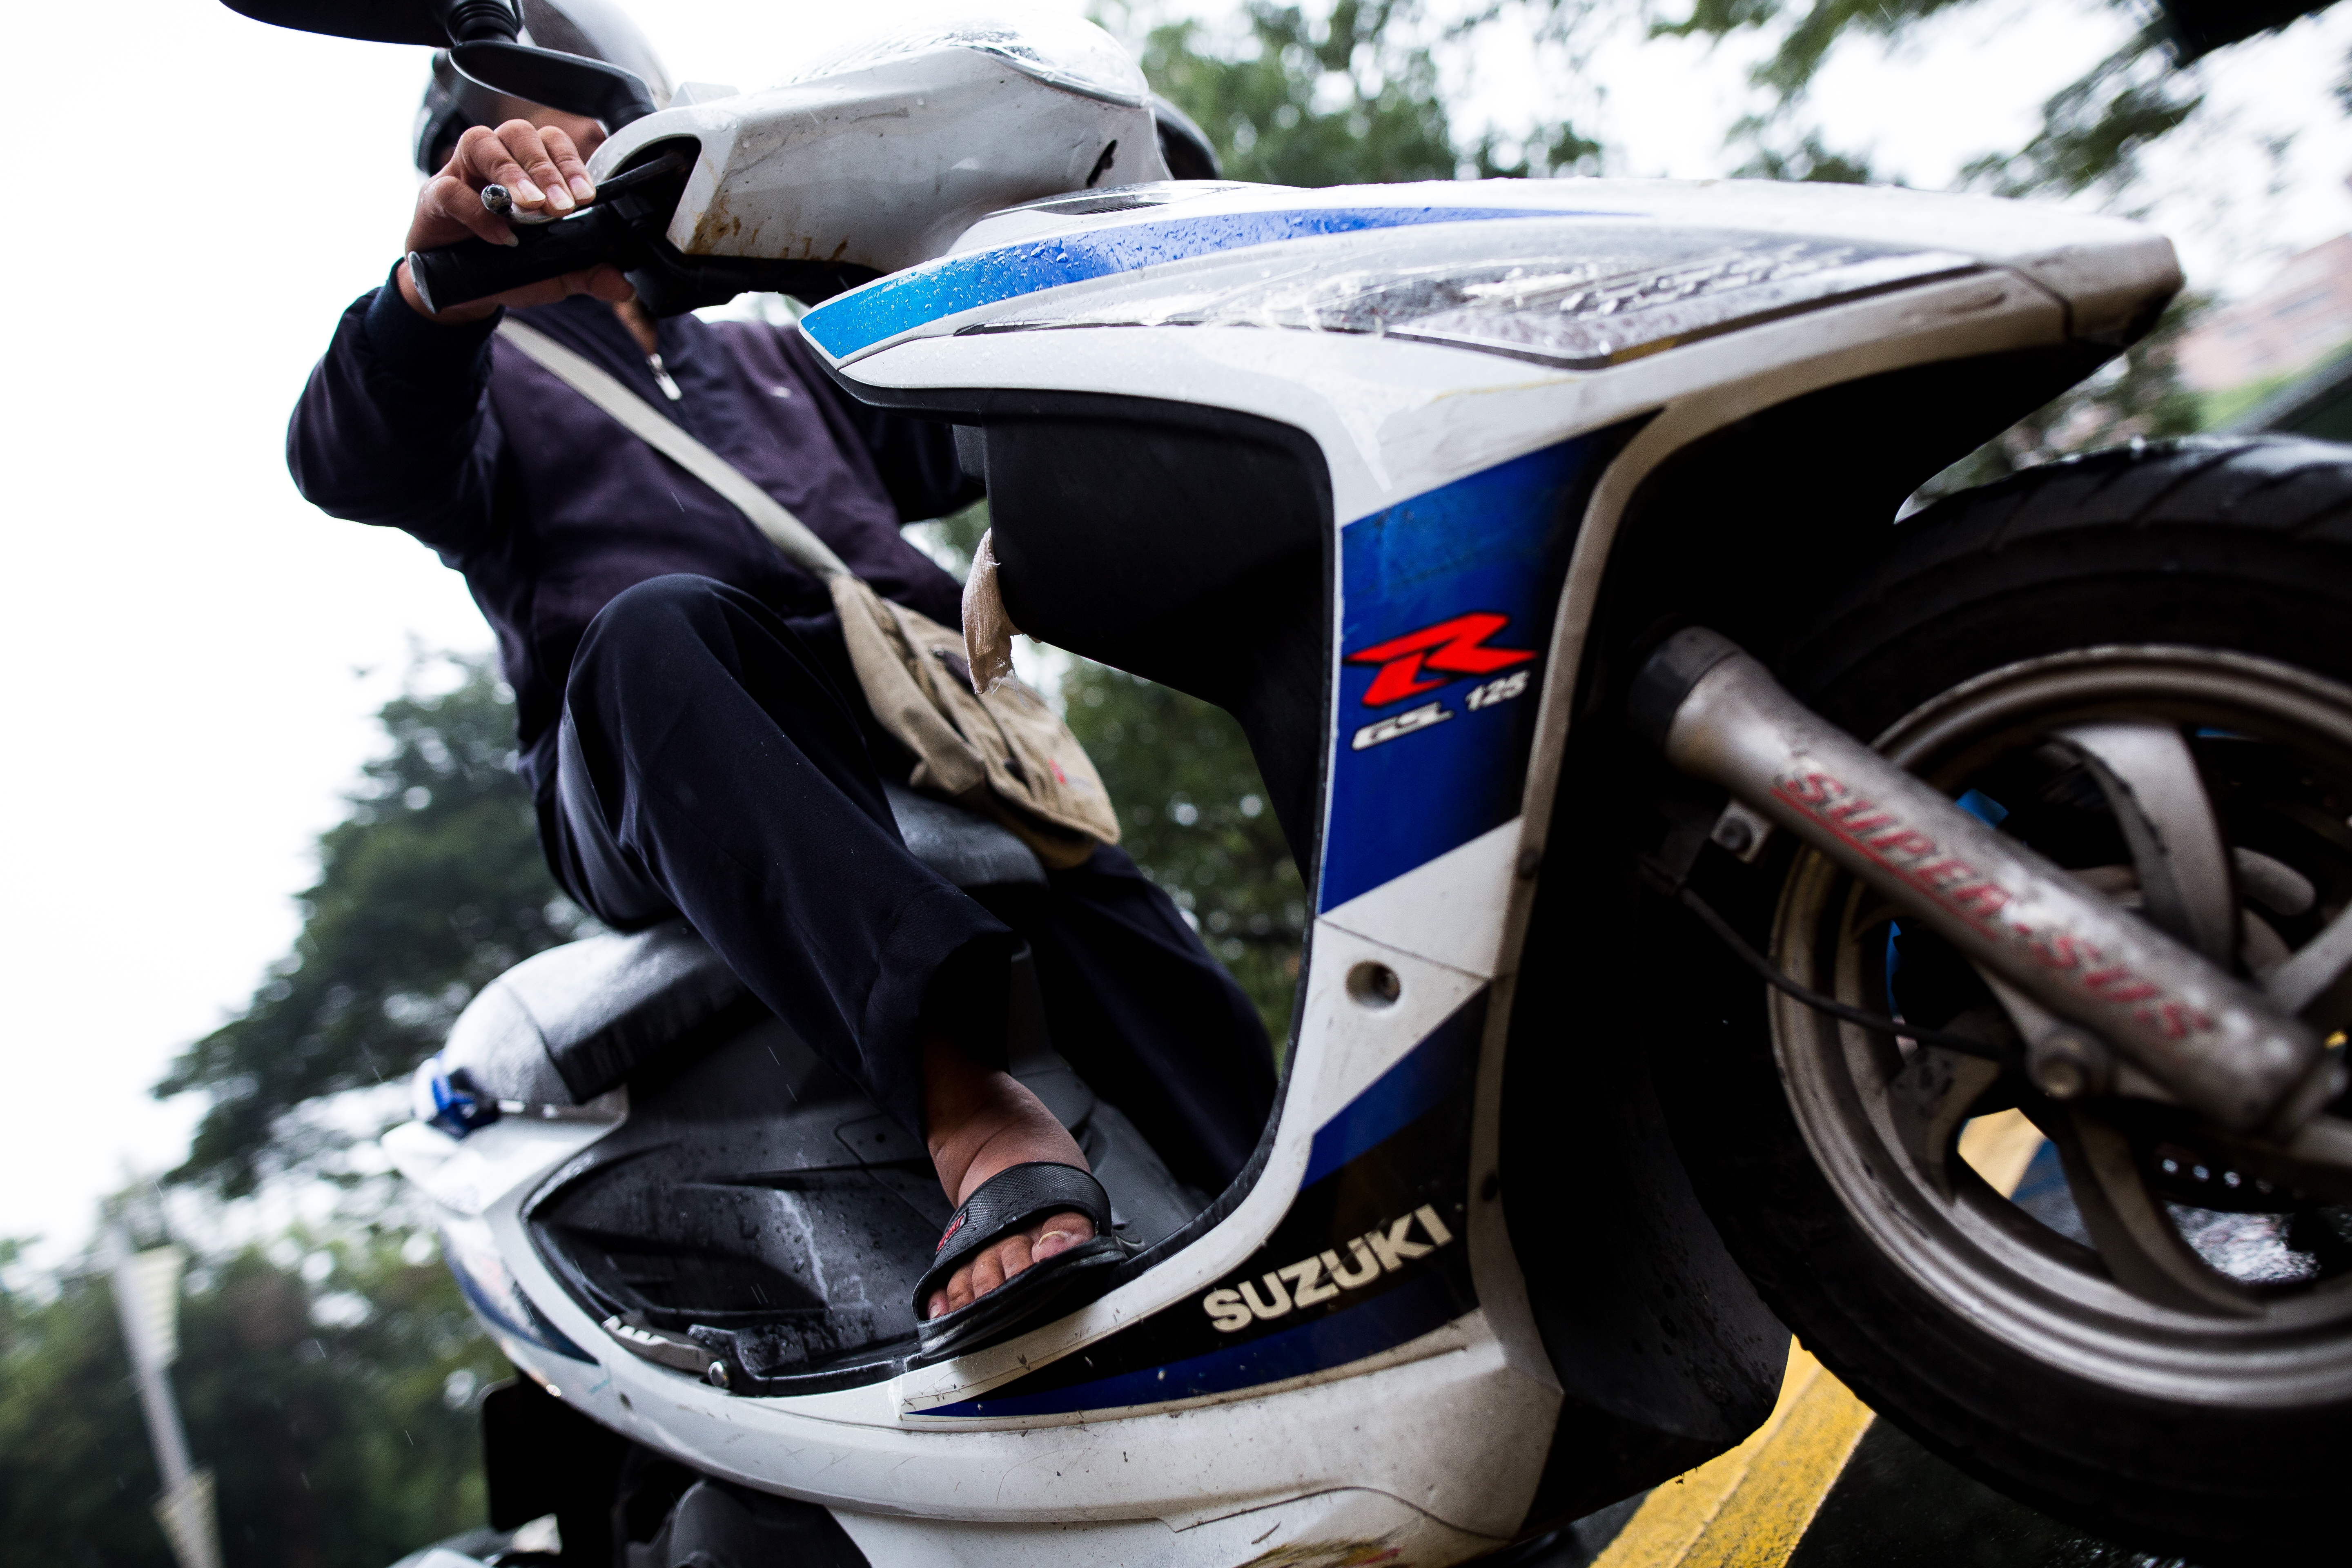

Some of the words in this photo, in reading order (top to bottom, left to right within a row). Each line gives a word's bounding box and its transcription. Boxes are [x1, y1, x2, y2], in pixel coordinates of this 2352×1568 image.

[1349, 612, 1538, 707] R
[1465, 670, 1530, 711] 125
[1203, 1204, 1453, 1332] SUZUKI
